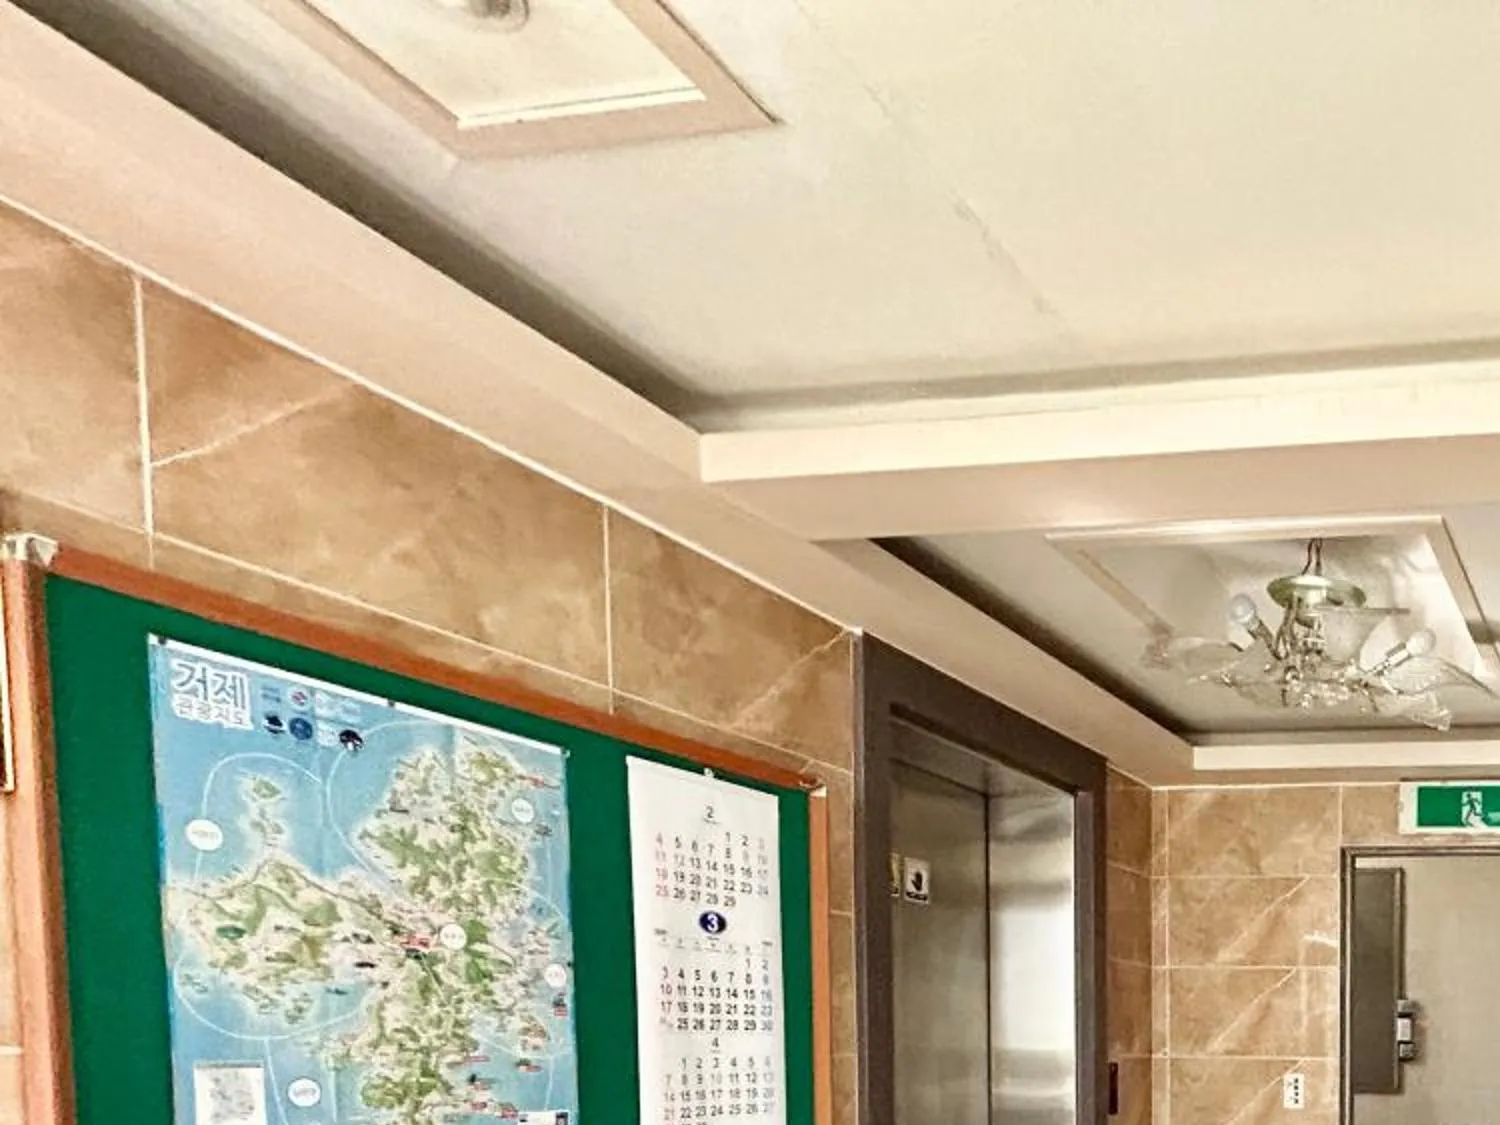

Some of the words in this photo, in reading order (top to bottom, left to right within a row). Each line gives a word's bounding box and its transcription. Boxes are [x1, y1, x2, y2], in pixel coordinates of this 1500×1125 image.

[177, 662, 247, 711] 거제
[705, 806, 714, 818] 2
[707, 913, 718, 931] 3
[712, 1038, 719, 1047] 4
